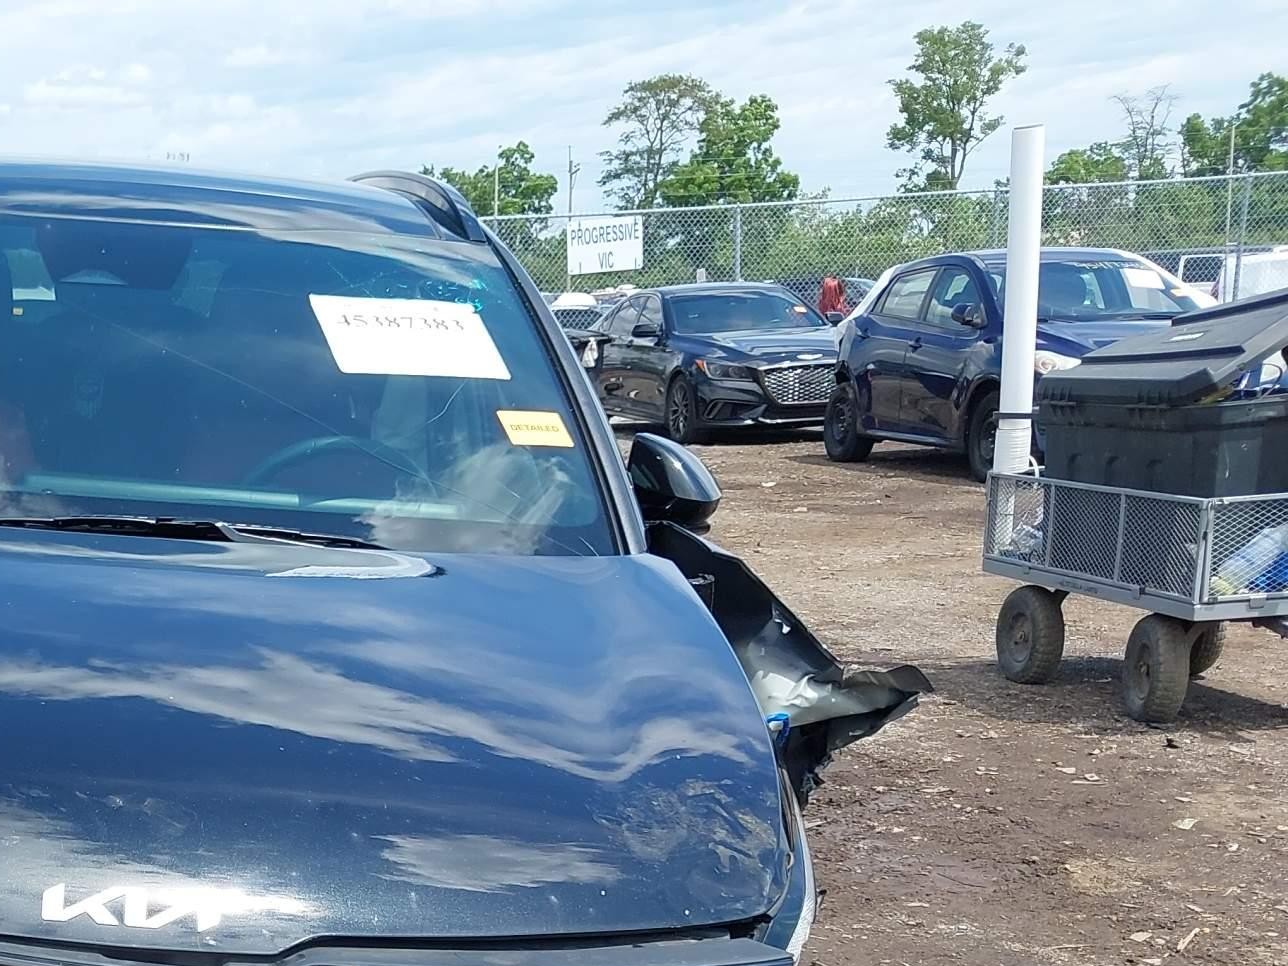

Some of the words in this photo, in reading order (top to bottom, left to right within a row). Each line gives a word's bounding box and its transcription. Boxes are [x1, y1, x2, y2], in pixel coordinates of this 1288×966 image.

[571, 223, 639, 246] PROGRESSIVE
[598, 251, 614, 270] VIC
[337, 313, 464, 331] 45387383
[510, 424, 559, 433] DETAILED
[40, 882, 224, 933] KIA
